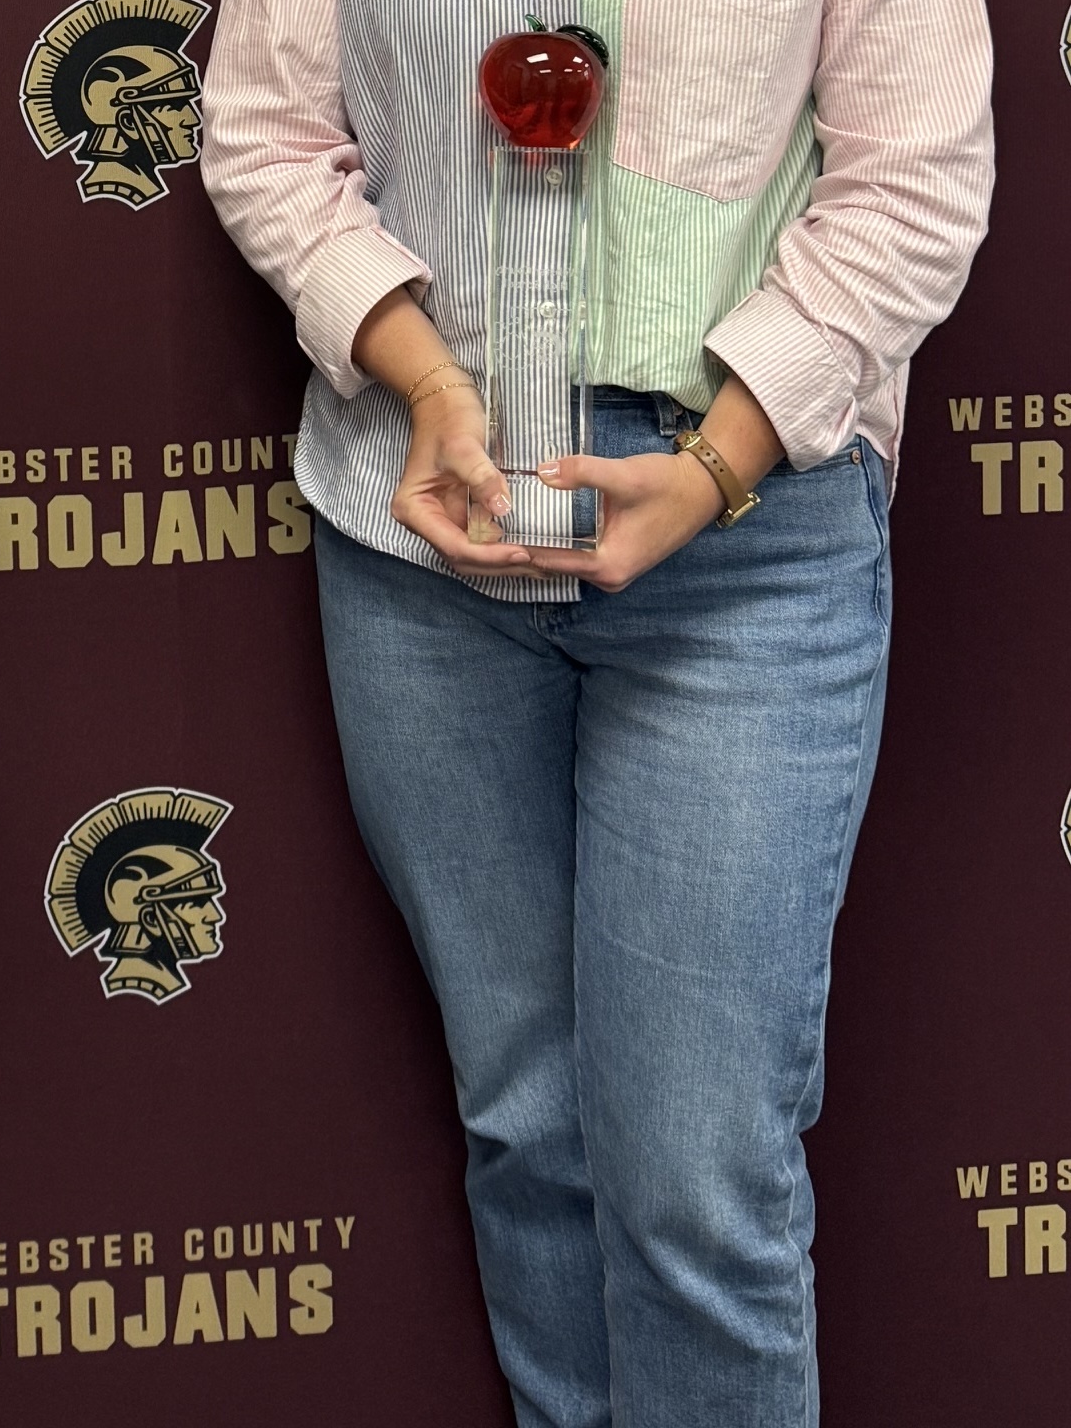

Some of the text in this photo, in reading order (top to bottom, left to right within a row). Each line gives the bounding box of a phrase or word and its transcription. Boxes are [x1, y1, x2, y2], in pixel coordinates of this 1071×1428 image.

[948, 392, 1071, 432] WEBS
[970, 439, 1064, 516] TR
[184, 1215, 356, 1262] COUNTY
[977, 1203, 1067, 1279] TR
